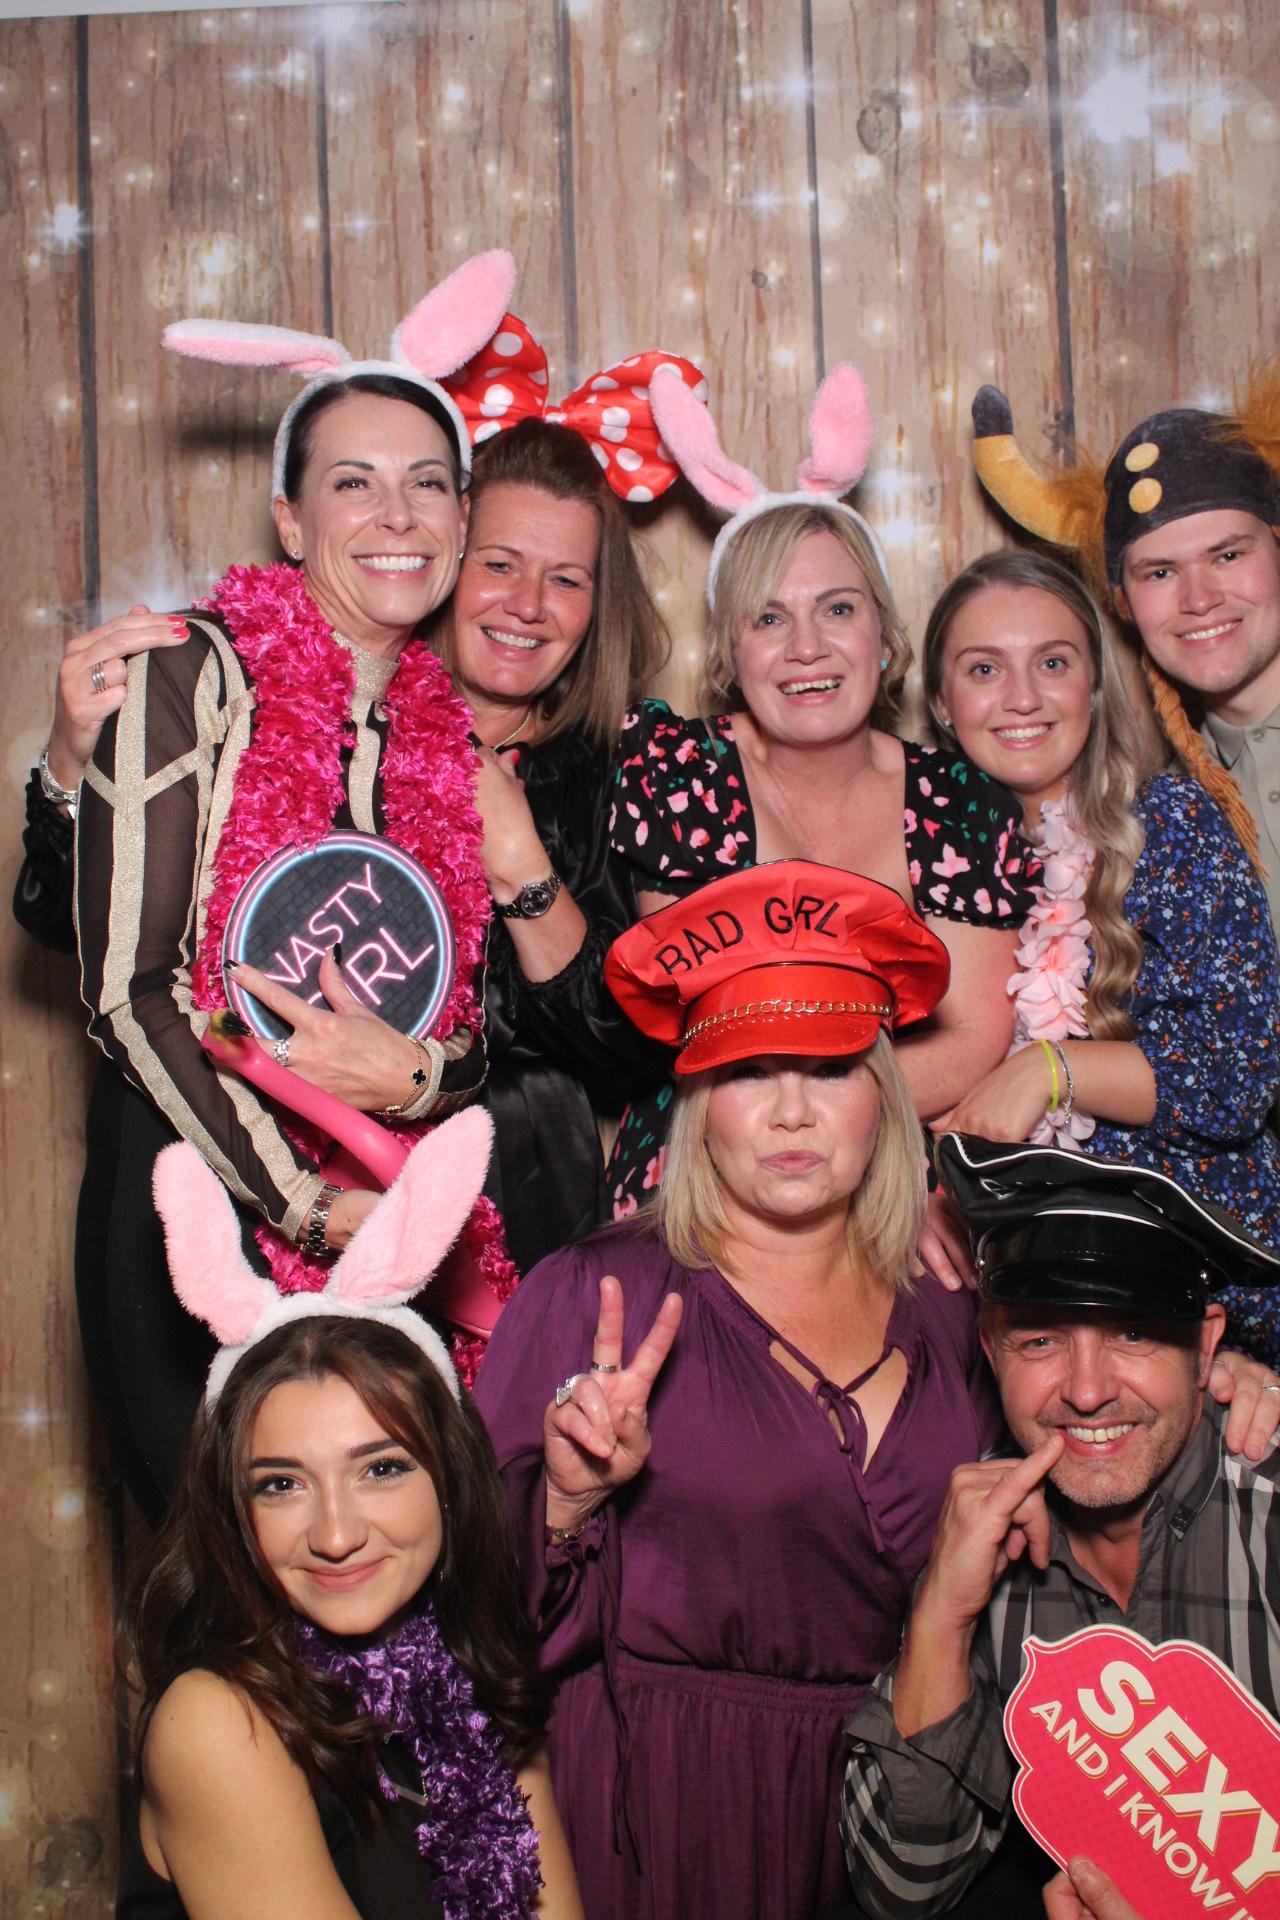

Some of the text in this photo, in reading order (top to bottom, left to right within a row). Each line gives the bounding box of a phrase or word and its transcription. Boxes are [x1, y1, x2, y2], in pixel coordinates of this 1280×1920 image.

[263, 862, 382, 984] NASTY
[307, 927, 435, 1006] RL
[654, 895, 840, 976] BAD GRL
[1029, 1700, 1109, 1778] AND
[1103, 1774, 1128, 1800] I
[1118, 1791, 1236, 1911] KNOW
[1076, 1660, 1280, 1893] SEXY
